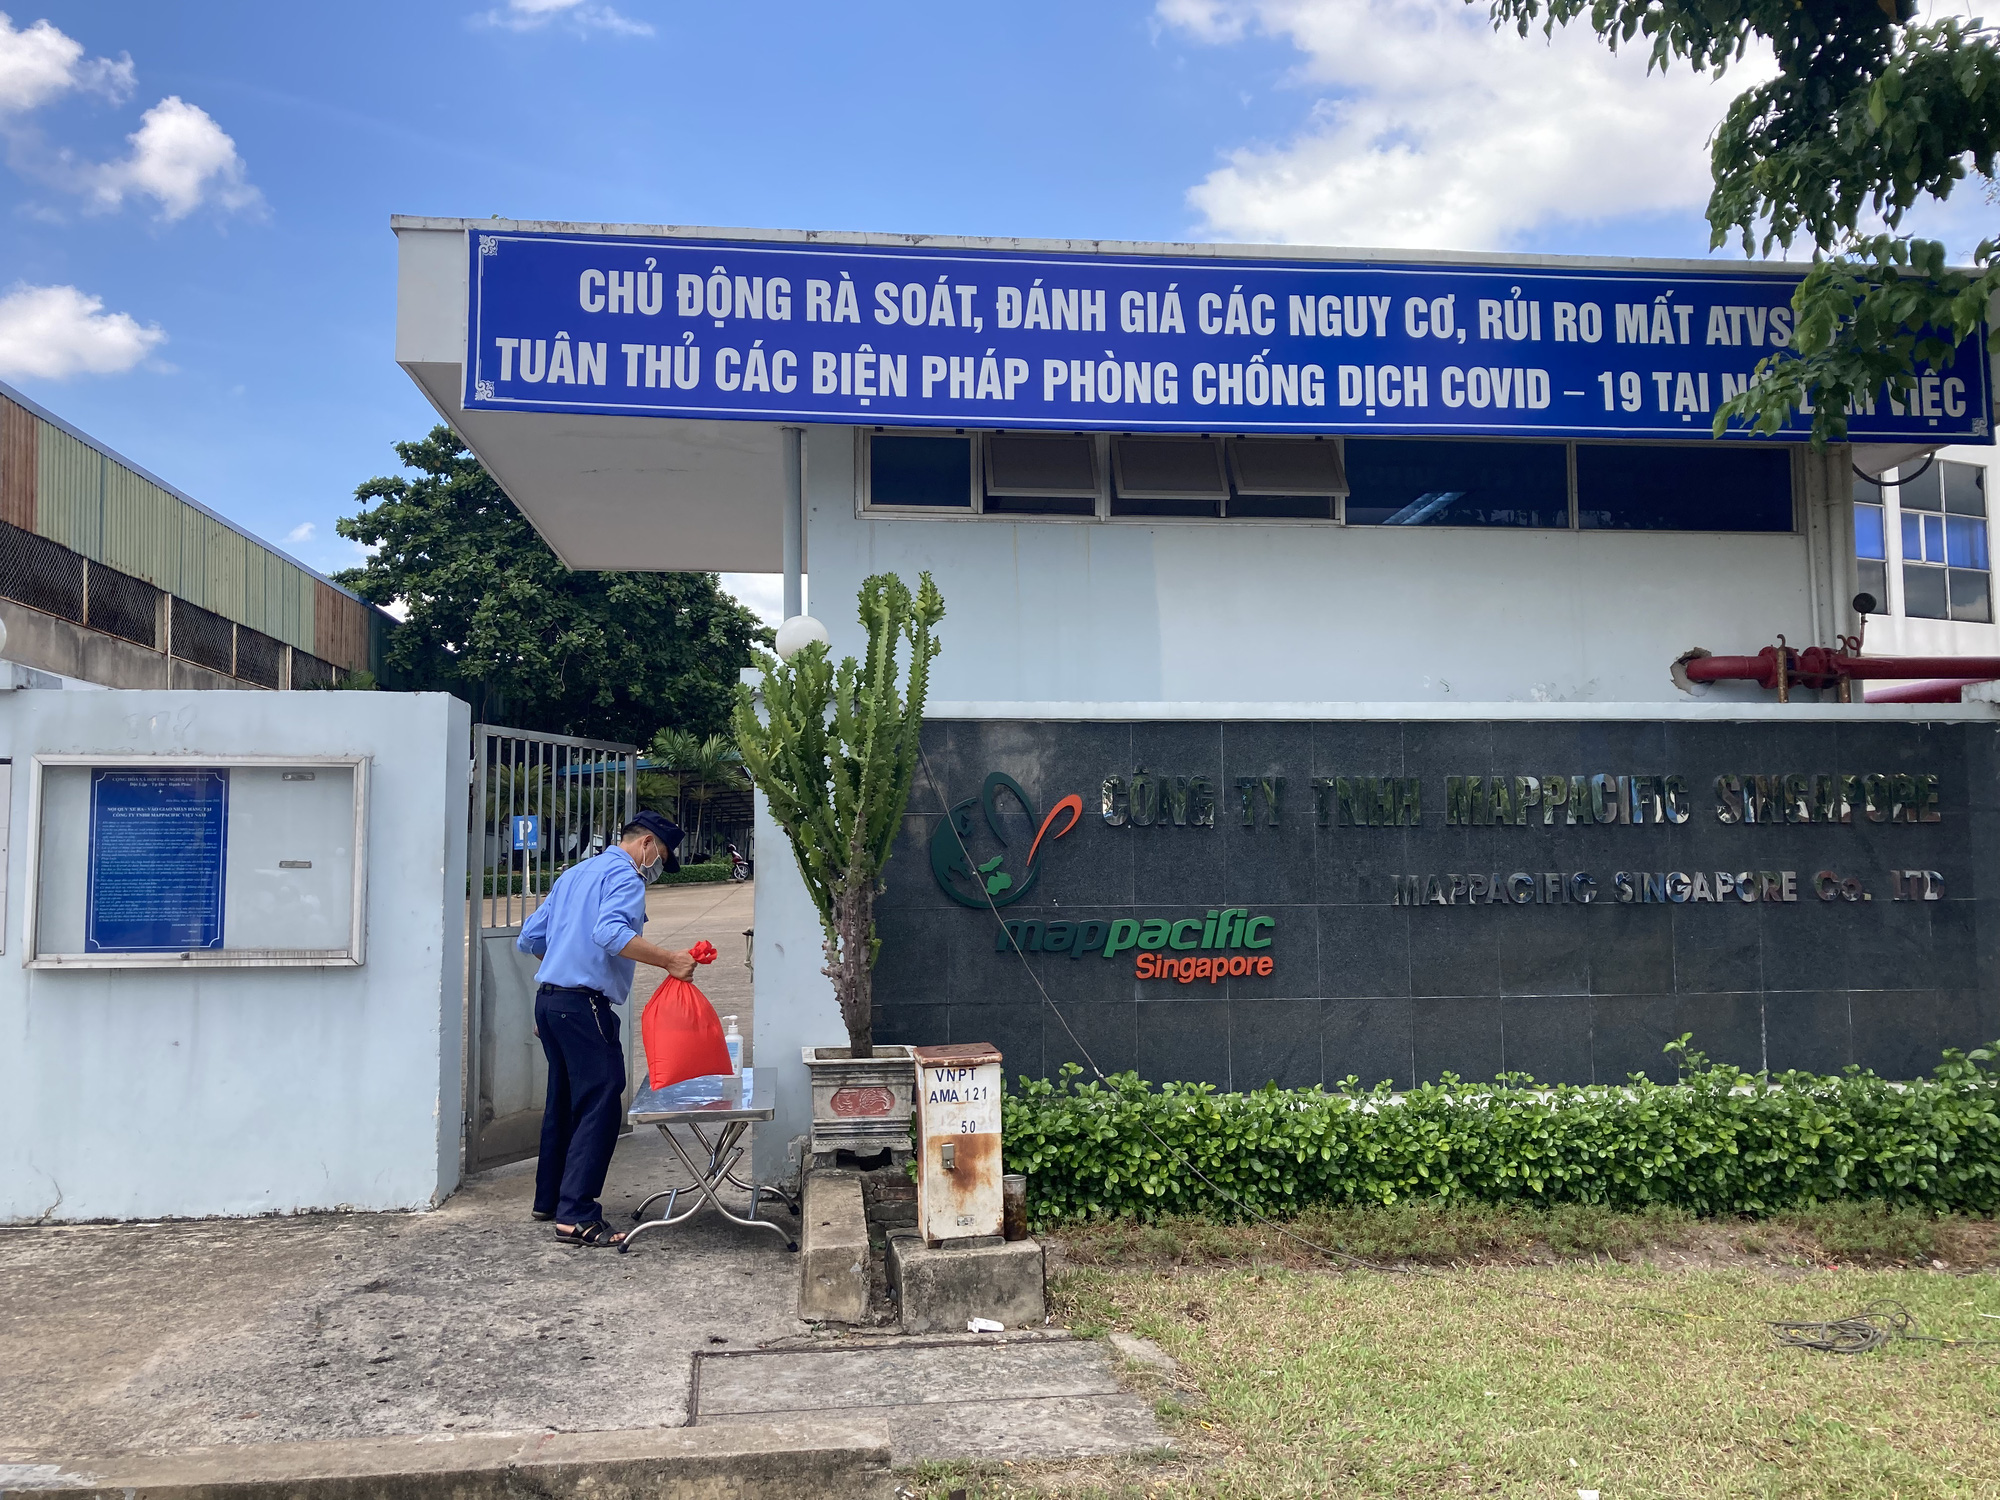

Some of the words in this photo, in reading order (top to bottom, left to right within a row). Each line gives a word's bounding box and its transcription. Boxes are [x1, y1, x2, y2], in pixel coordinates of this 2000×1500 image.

[579, 257, 664, 316] CHỦ
[676, 265, 792, 328] ĐỘNG
[806, 271, 862, 324] RÀ
[874, 275, 985, 334] SOÁT,
[996, 278, 1107, 332] ĐÁNH
[1119, 282, 1186, 334] GIÁ
[1199, 284, 1276, 336] CÁC
[1289, 294, 1392, 338] NGUY
[1405, 293, 1467, 345] CƠ,
[1479, 285, 1541, 342] RỦI
[1553, 300, 1604, 344] RO
[1615, 289, 1695, 345] MẤT
[496, 330, 607, 386] TUÂN
[621, 331, 701, 390] THỦ
[714, 339, 798, 394] CÁC
[812, 343, 908, 406] BIỆN
[922, 347, 1030, 401] PHÁP
[1043, 349, 1179, 404] PHÒNG
[1192, 348, 1326, 406] CHỐNG
[1338, 364, 1428, 416] DỊCH
[1441, 366, 1551, 410] COVID
[1597, 371, 1642, 413] 19
[1652, 372, 1711, 422] TẠI
[1885, 367, 1967, 427] VIỆC
[1101, 766, 1216, 828] CÔNG
[1233, 775, 1288, 827] TY
[1311, 775, 1421, 827] TNHH
[1445, 773, 1692, 827] MAPPACIFIC
[1714, 772, 1942, 827] SINGAPORE
[1390, 871, 1599, 907] MAPPACIFIC
[1613, 870, 1798, 904] SINGAPORE
[1892, 870, 1946, 902] LTD
[995, 908, 1276, 960] mappacific
[1135, 952, 1274, 984] Singapore
[935, 1067, 977, 1082] VNPT
[929, 1088, 960, 1104] AMA
[964, 1086, 987, 1101] 121
[961, 1120, 976, 1134] 50
